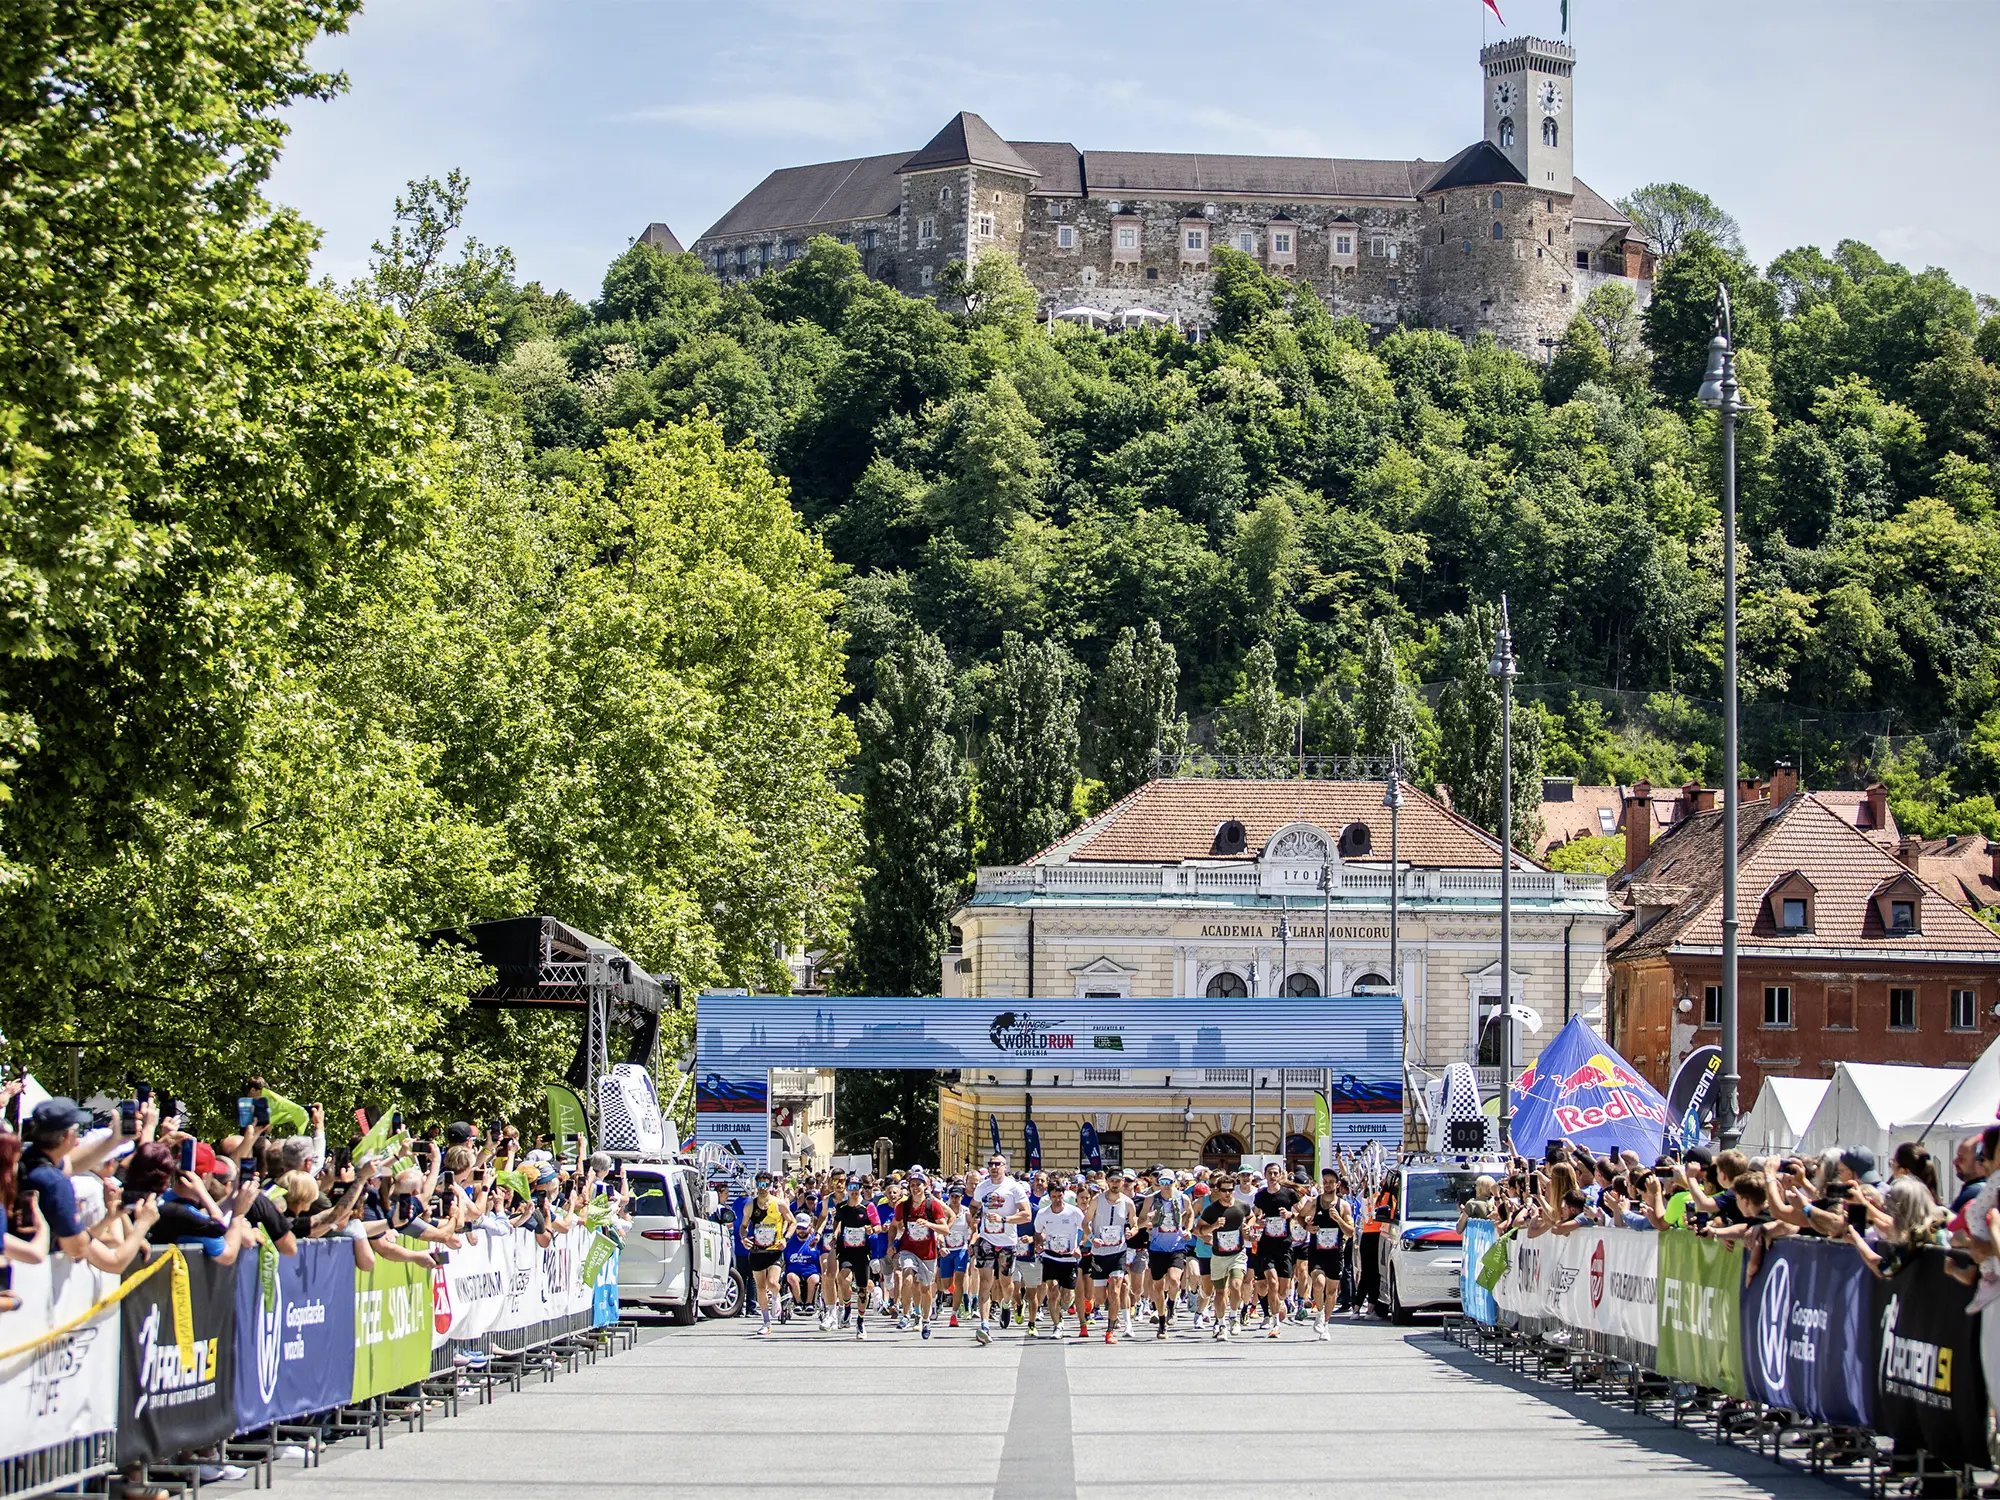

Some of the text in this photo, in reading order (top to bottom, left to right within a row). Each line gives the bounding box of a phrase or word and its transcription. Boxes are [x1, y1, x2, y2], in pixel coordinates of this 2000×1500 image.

[1284, 870, 1319, 881] 1701
[1200, 925, 1400, 939] ACADEMIA PILHARMONICORU
[1556, 1092, 1629, 1133] Red
[711, 1124, 751, 1133] LJUBLJANA
[1457, 1129, 1478, 1141] 0.0
